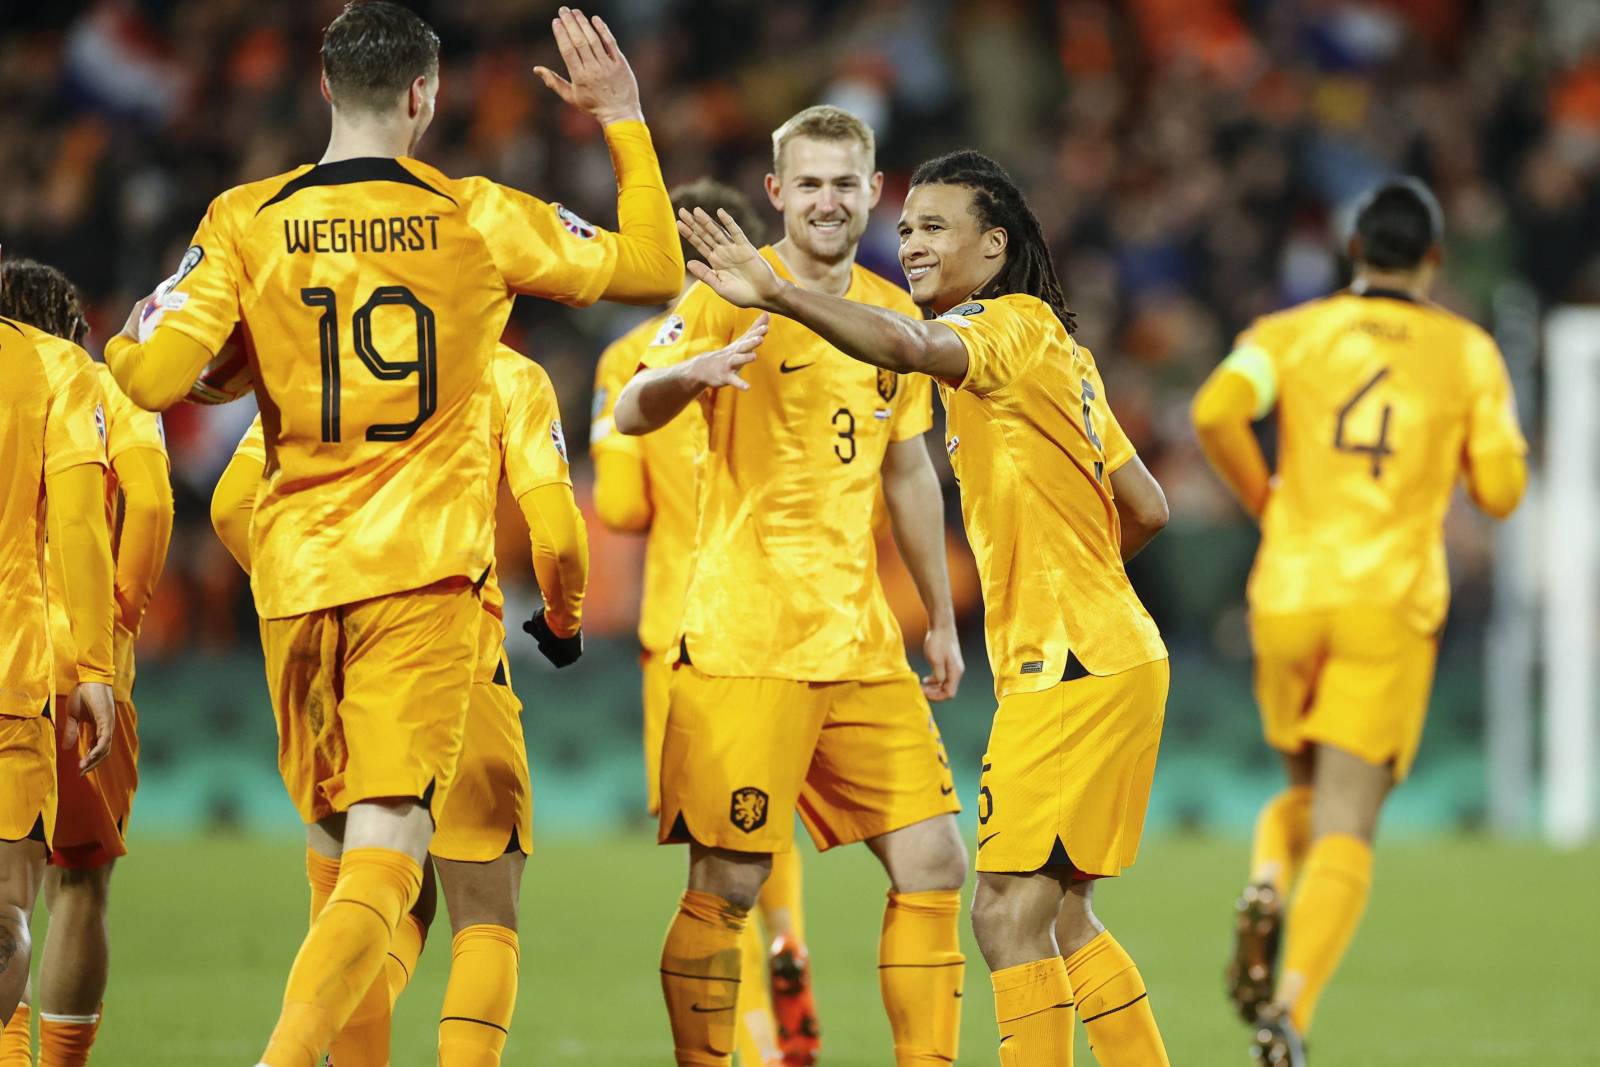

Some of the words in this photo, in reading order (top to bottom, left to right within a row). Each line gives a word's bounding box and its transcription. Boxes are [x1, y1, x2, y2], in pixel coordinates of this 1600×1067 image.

[284, 215, 440, 255] WEGHORST
[300, 285, 438, 443] 19
[831, 407, 857, 465] 3
[1335, 366, 1393, 479] 4
